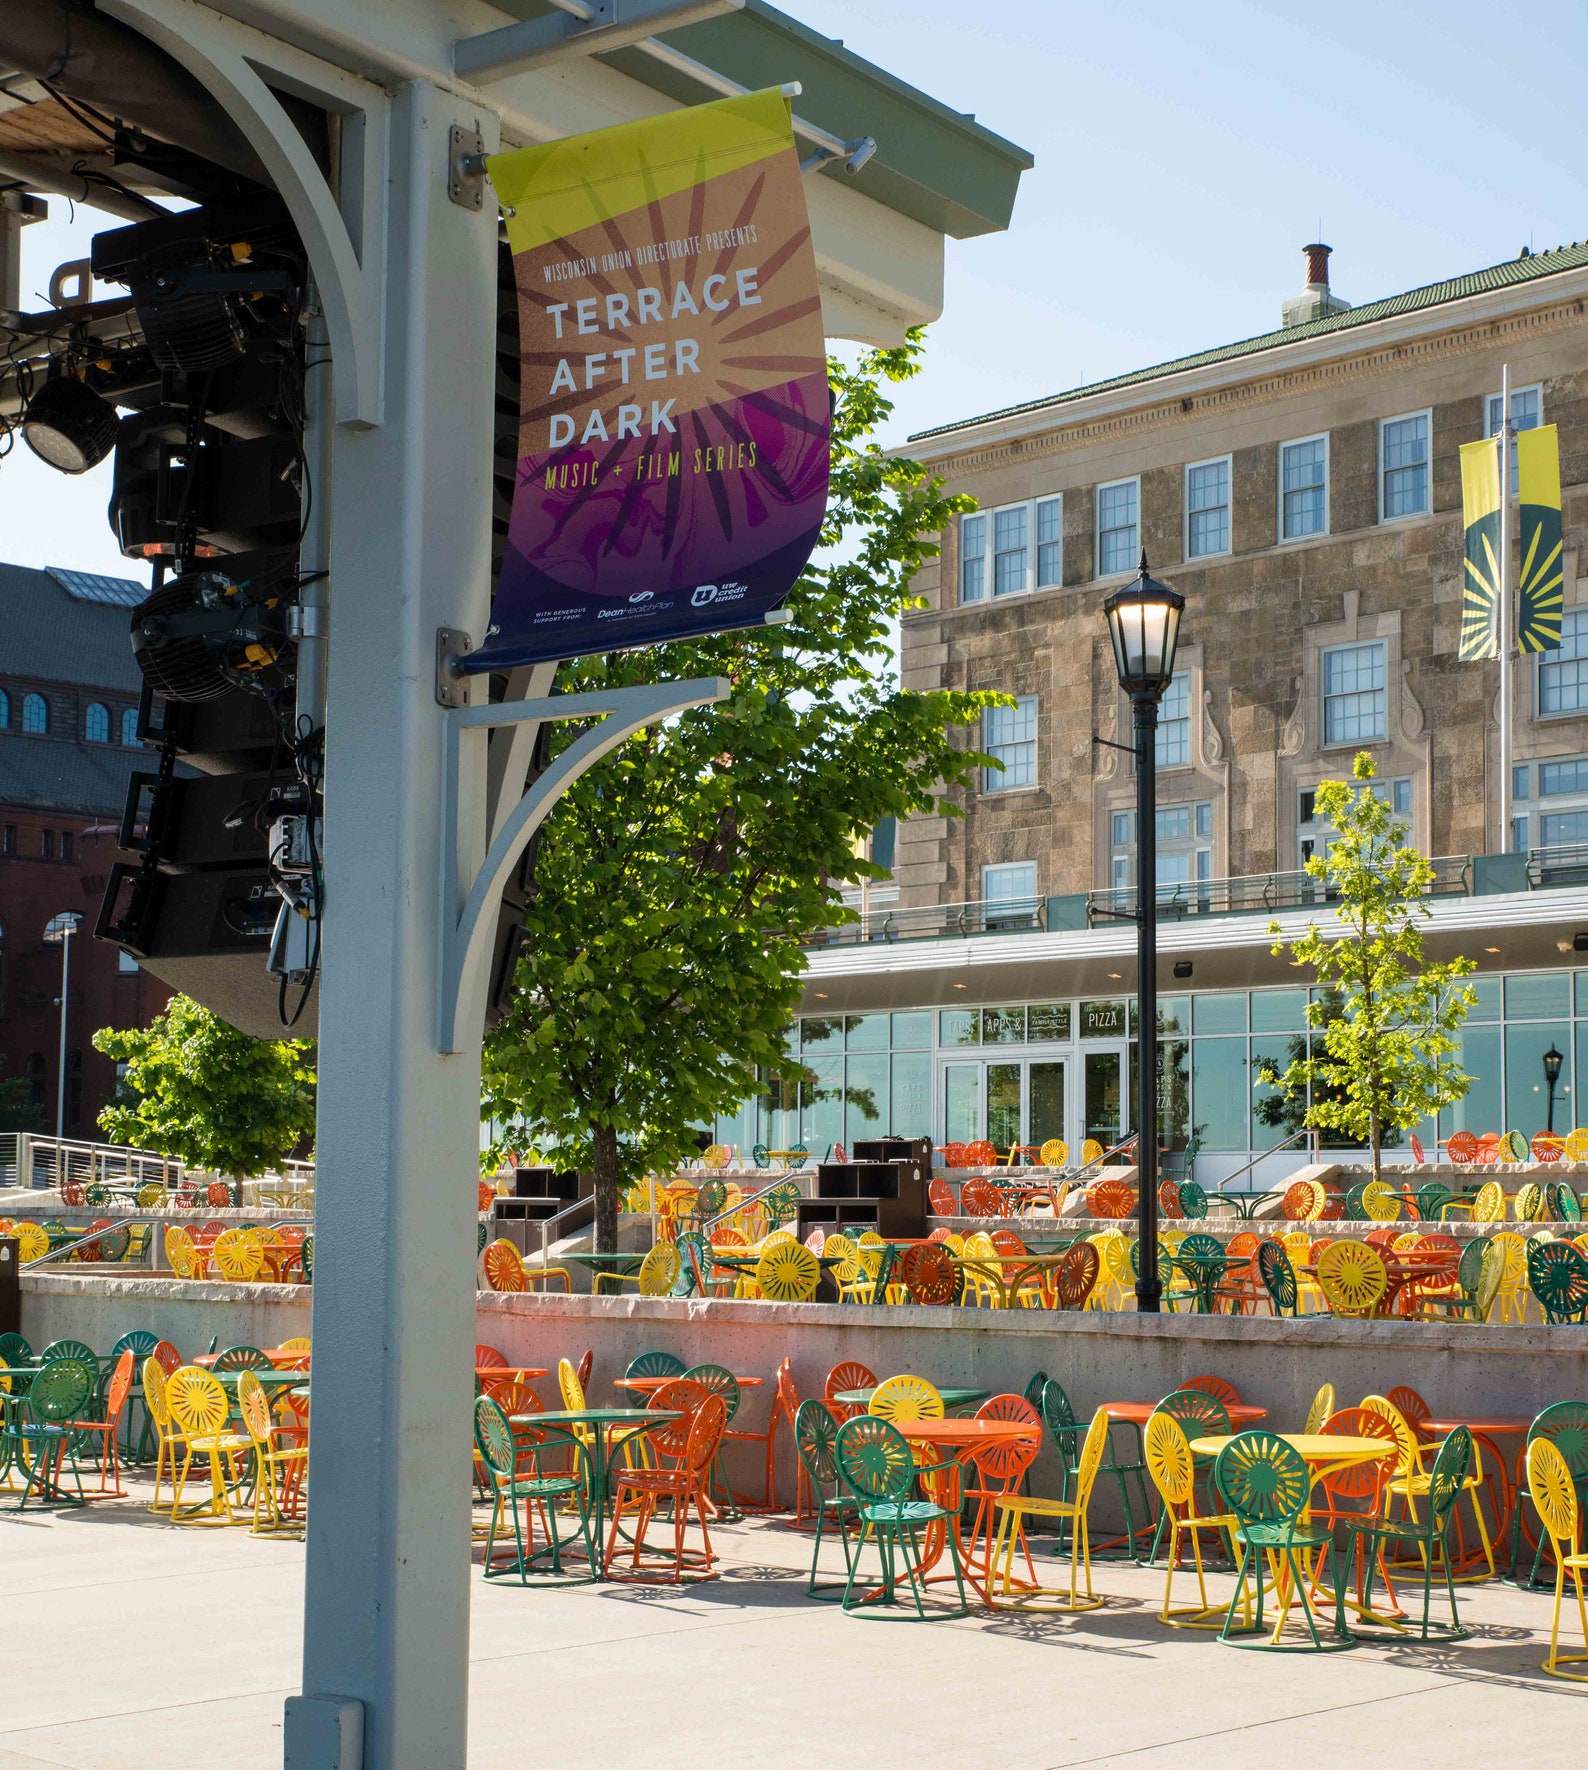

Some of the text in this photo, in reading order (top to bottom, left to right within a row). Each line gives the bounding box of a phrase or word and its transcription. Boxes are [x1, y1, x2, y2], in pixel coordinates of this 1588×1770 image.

[543, 224, 758, 283] WISCONSIN UNION DIRECTORATE PRESENTS
[546, 267, 762, 339] TERRACE
[549, 338, 701, 395] AFTER
[549, 398, 677, 448] DARK
[545, 461, 600, 490] MUSIC
[637, 451, 680, 480] FILM
[694, 441, 757, 473] SERIES
[714, 593, 745, 603] union
[718, 586, 748, 596] credit
[553, 607, 586, 616] GENEROUS
[533, 616, 561, 624] SUPPORT
[987, 1018, 1010, 1033] APPS
[1014, 1017, 1022, 1031] &
[1088, 1011, 1118, 1027] PIZZA
[1156, 1096, 1172, 1109] ZZA
